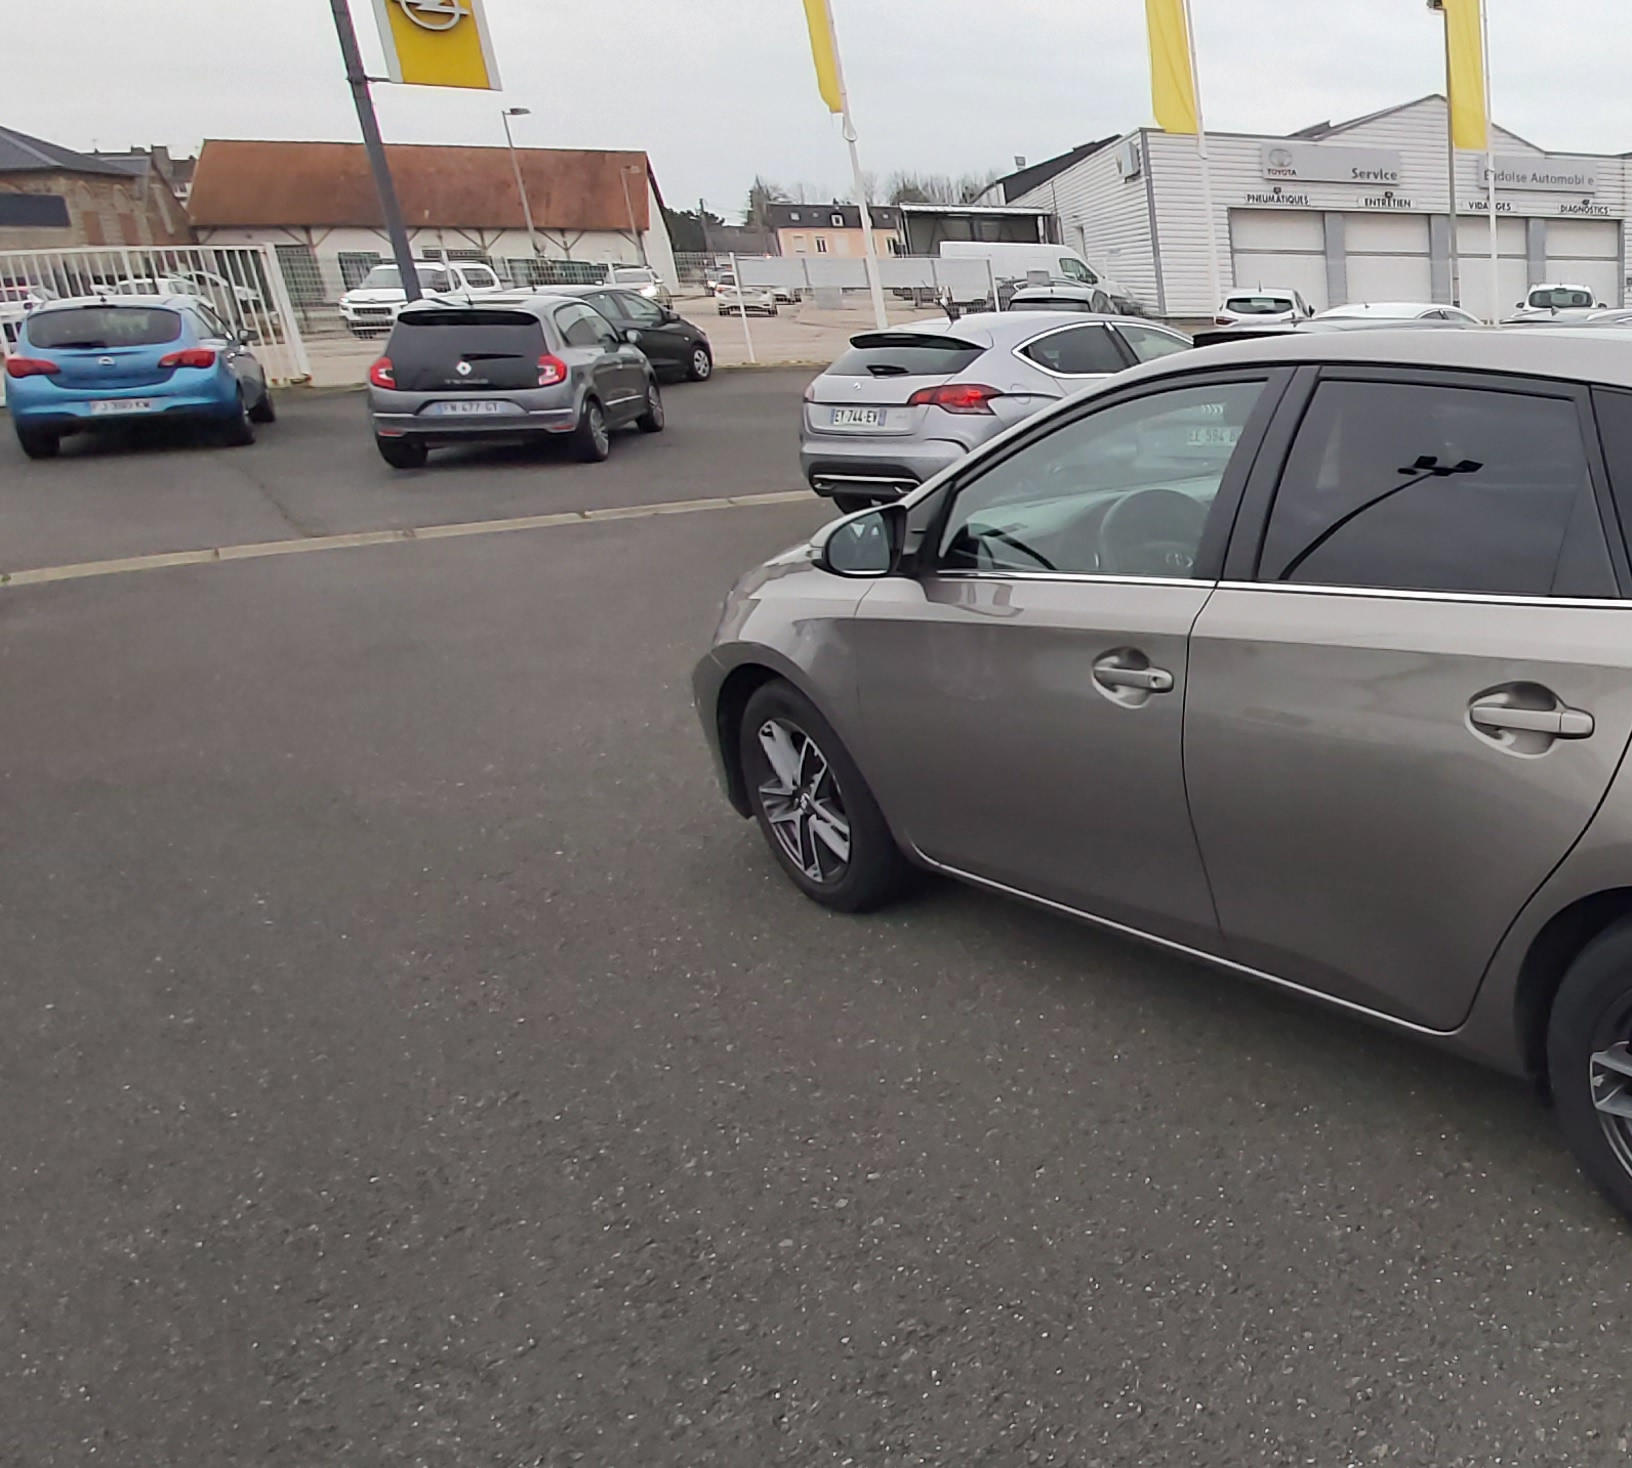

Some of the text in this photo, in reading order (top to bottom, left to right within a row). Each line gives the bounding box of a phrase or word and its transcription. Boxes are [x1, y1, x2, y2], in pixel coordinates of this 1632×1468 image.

[1267, 168, 1297, 176] TOYOTA
[1351, 167, 1397, 181] Service
[1484, 170, 1594, 186] Edoise Automobie
[1247, 194, 1309, 205] PNEUMATIQUES
[1364, 198, 1411, 208] ENTRETIEN
[1469, 202, 1511, 211] VIDAGES
[1560, 205, 1609, 214] DIAGNOSTICS
